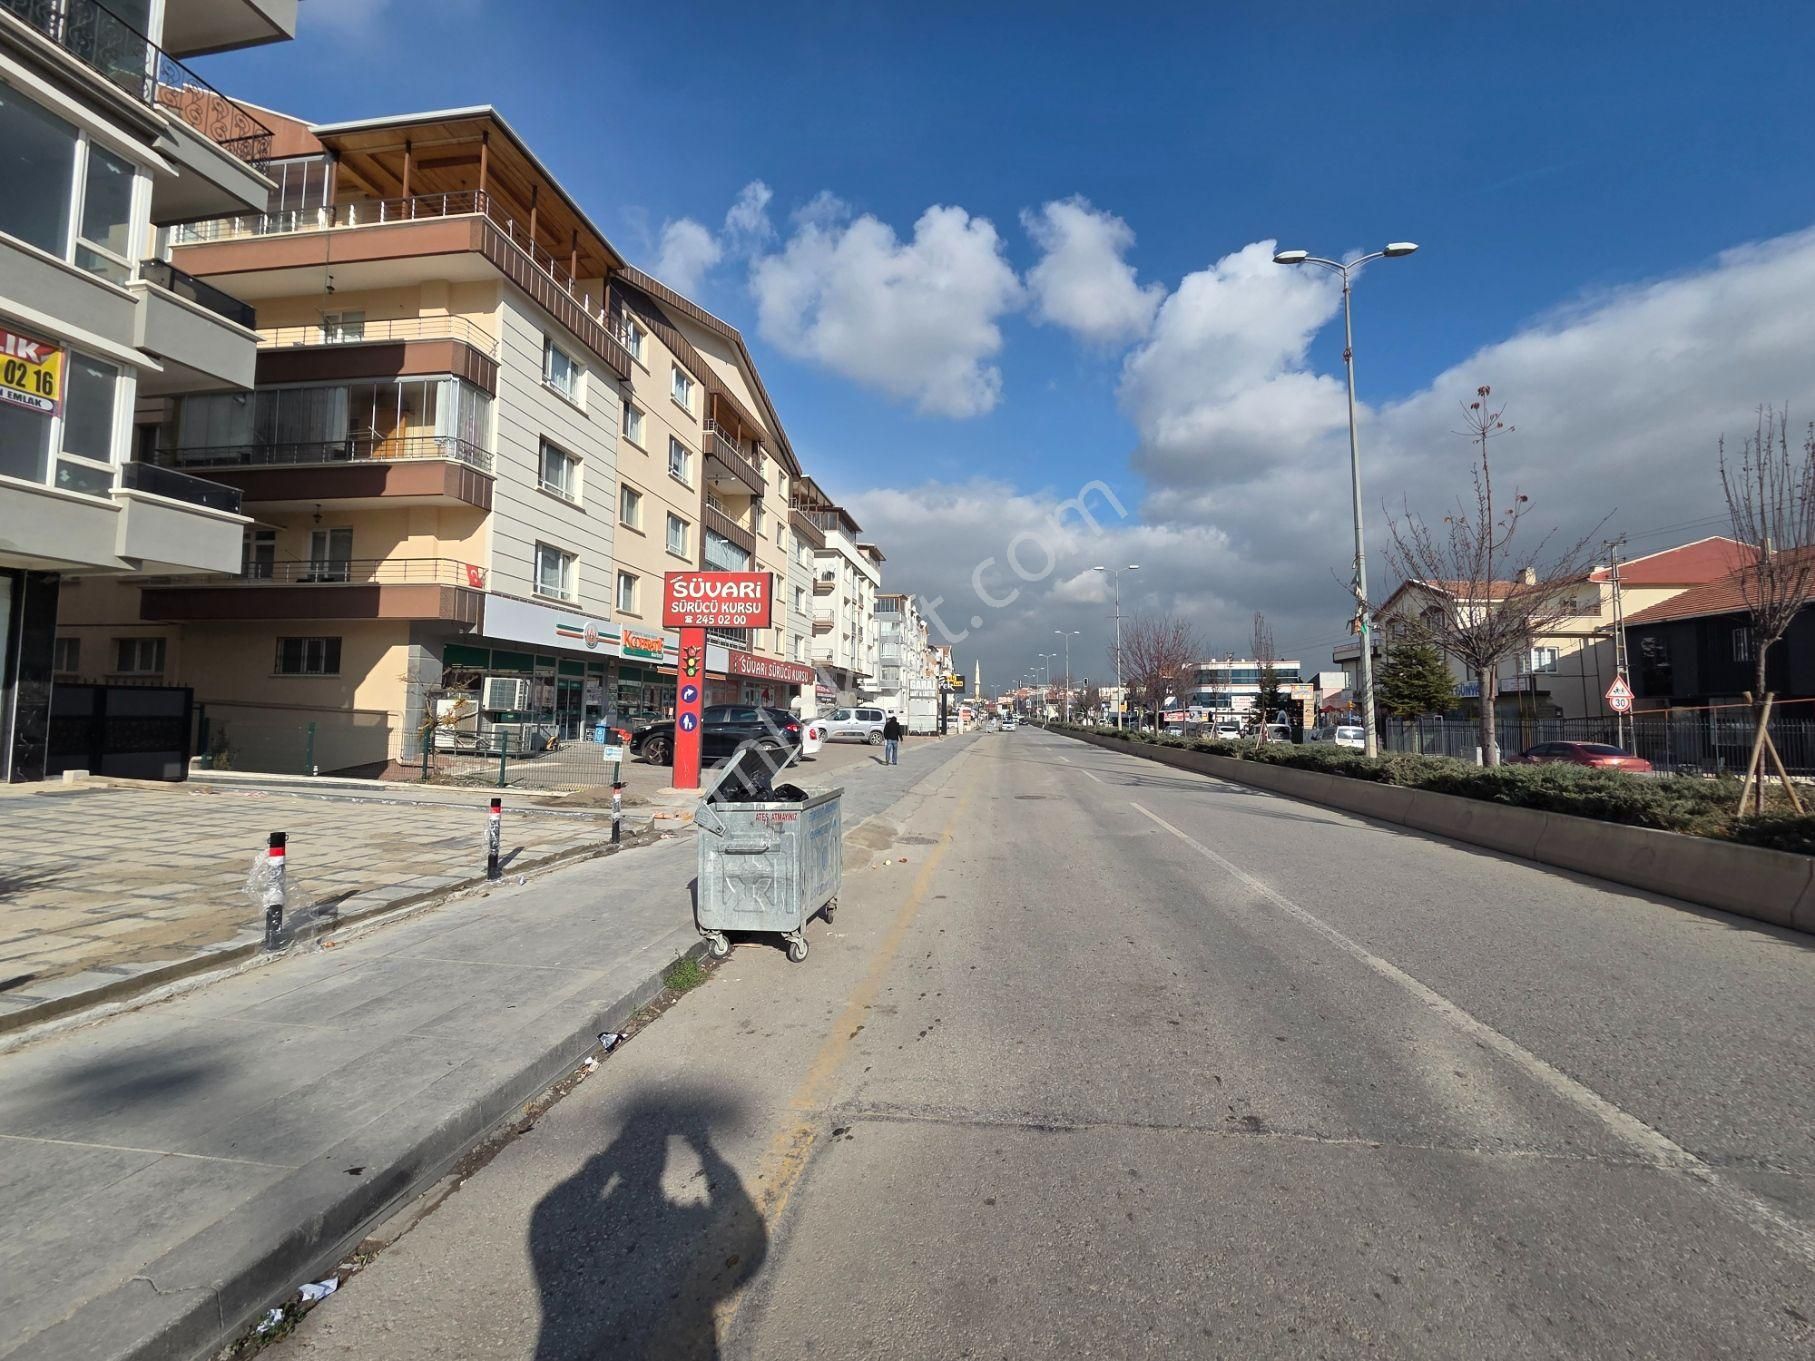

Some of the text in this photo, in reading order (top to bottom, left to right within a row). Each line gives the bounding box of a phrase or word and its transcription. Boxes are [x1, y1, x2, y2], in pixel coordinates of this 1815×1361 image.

[4, 359, 54, 395] 02 16
[7, 390, 42, 407] EMLAK
[671, 600, 762, 614] SÜRÜCÜ KURSU
[695, 615, 747, 625] 245 02 00
[768, 662, 791, 680] SÜRÜCÜ
[791, 669, 809, 683] KURSU
[1614, 699, 1626, 708] 30
[771, 812, 798, 821] ATMAYINIZ
